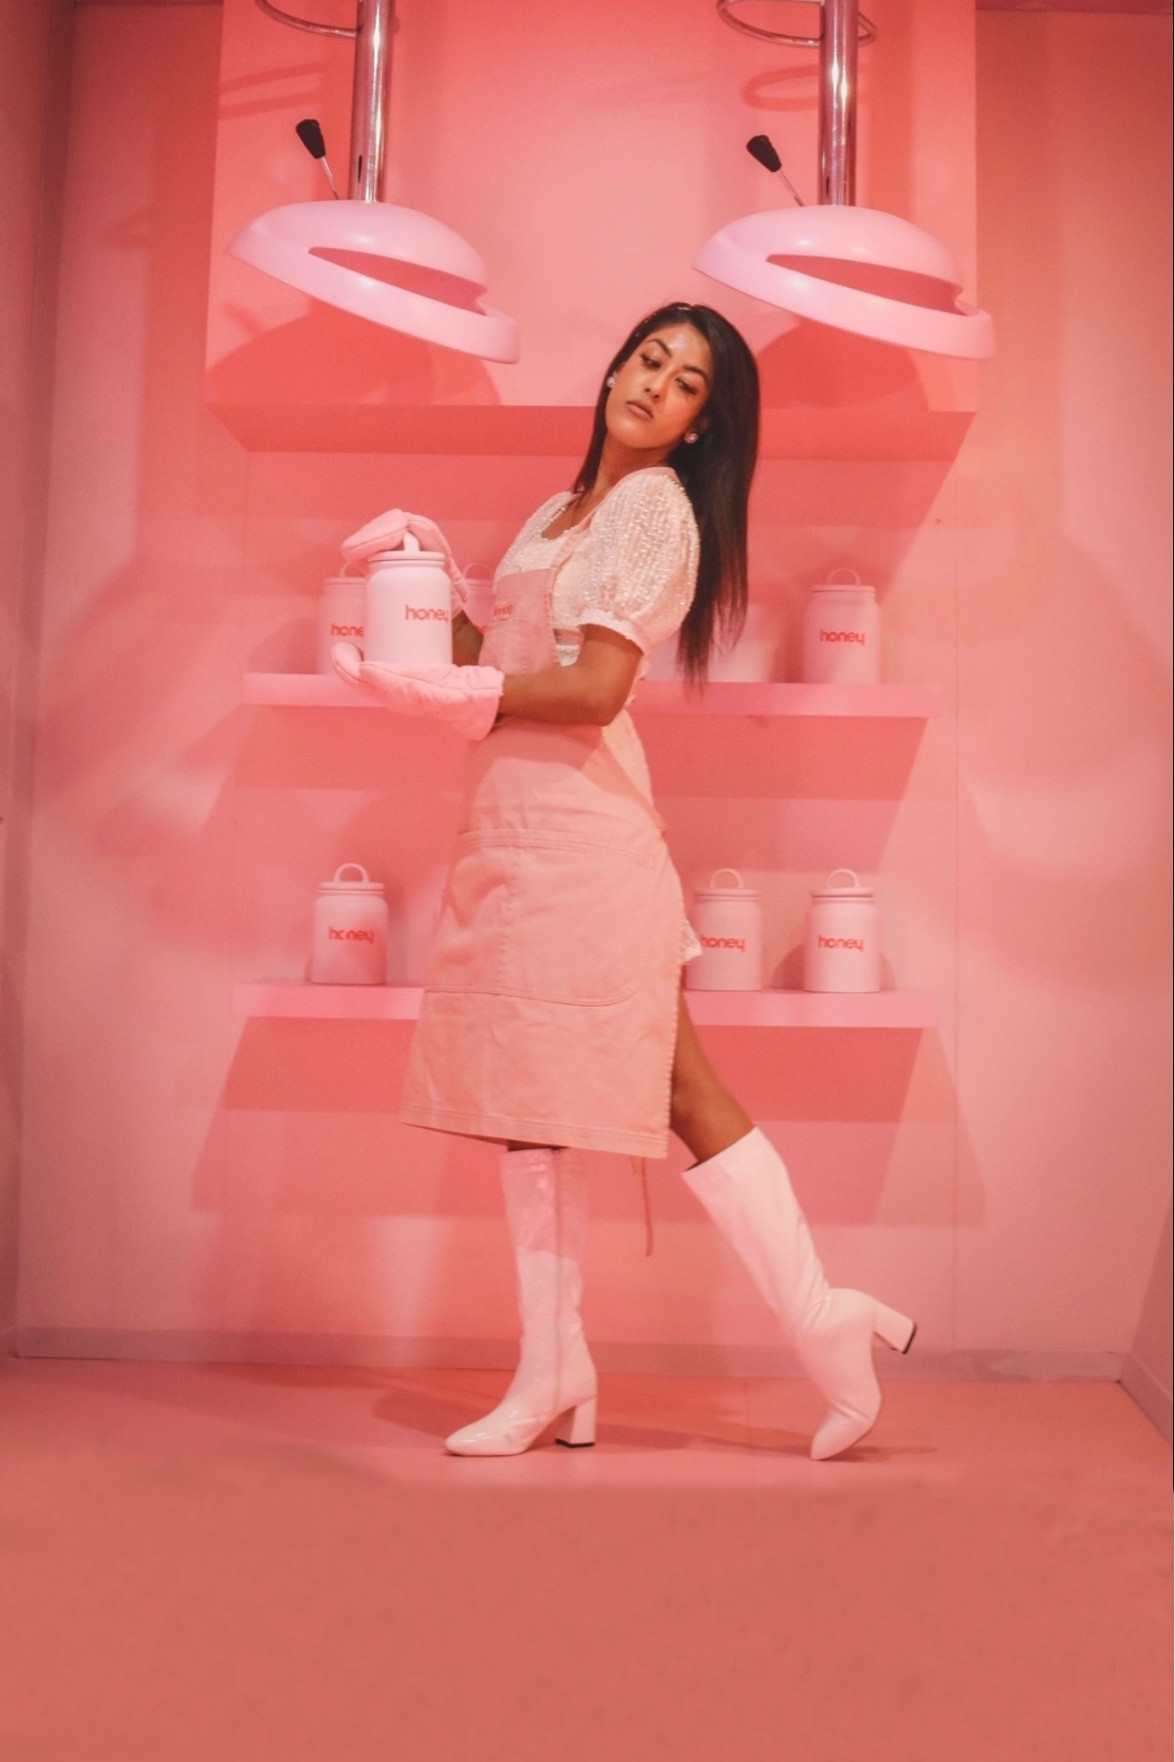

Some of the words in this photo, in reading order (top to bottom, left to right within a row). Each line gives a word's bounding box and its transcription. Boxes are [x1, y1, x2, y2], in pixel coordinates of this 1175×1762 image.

[820, 629, 865, 646] honey
[329, 926, 374, 944] honey
[818, 934, 864, 952] honey
